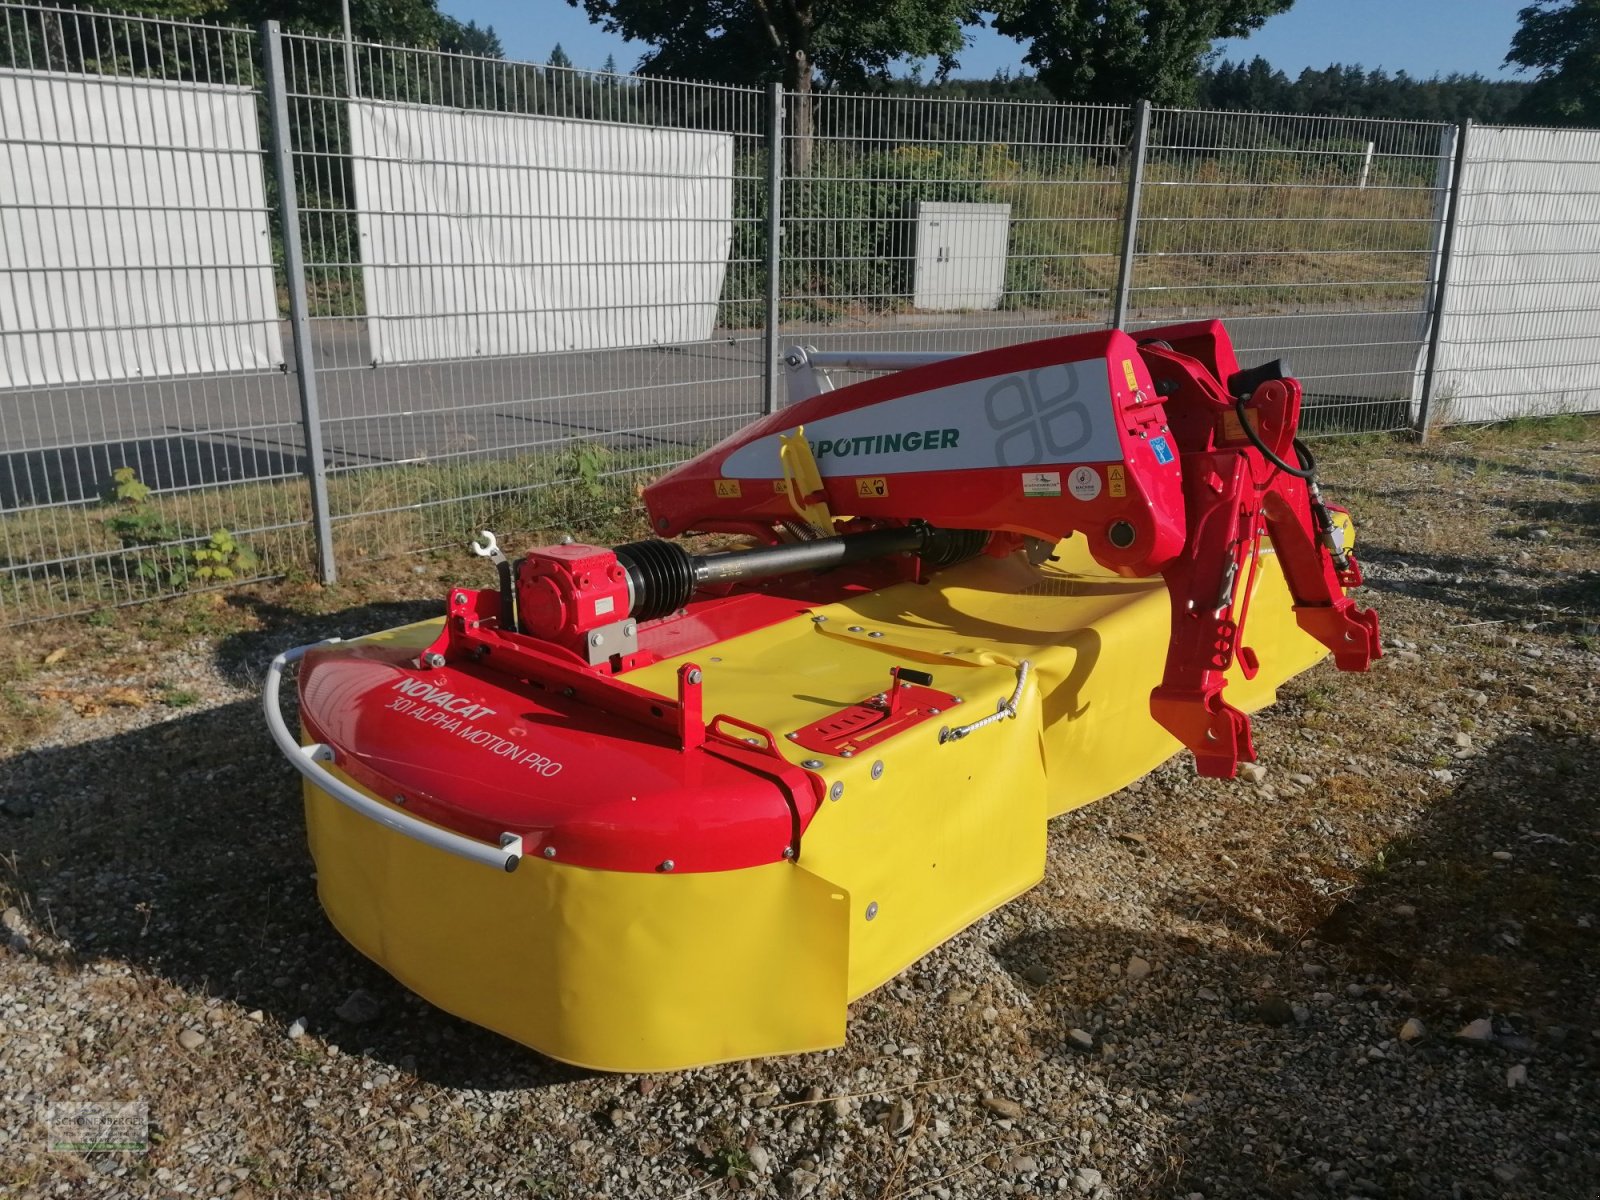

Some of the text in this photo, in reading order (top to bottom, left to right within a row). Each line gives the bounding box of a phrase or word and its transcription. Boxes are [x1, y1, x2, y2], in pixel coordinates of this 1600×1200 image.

[392, 678, 496, 720] NOVACAT
[385, 696, 563, 777] 301 ALPHA MOTION PRO
